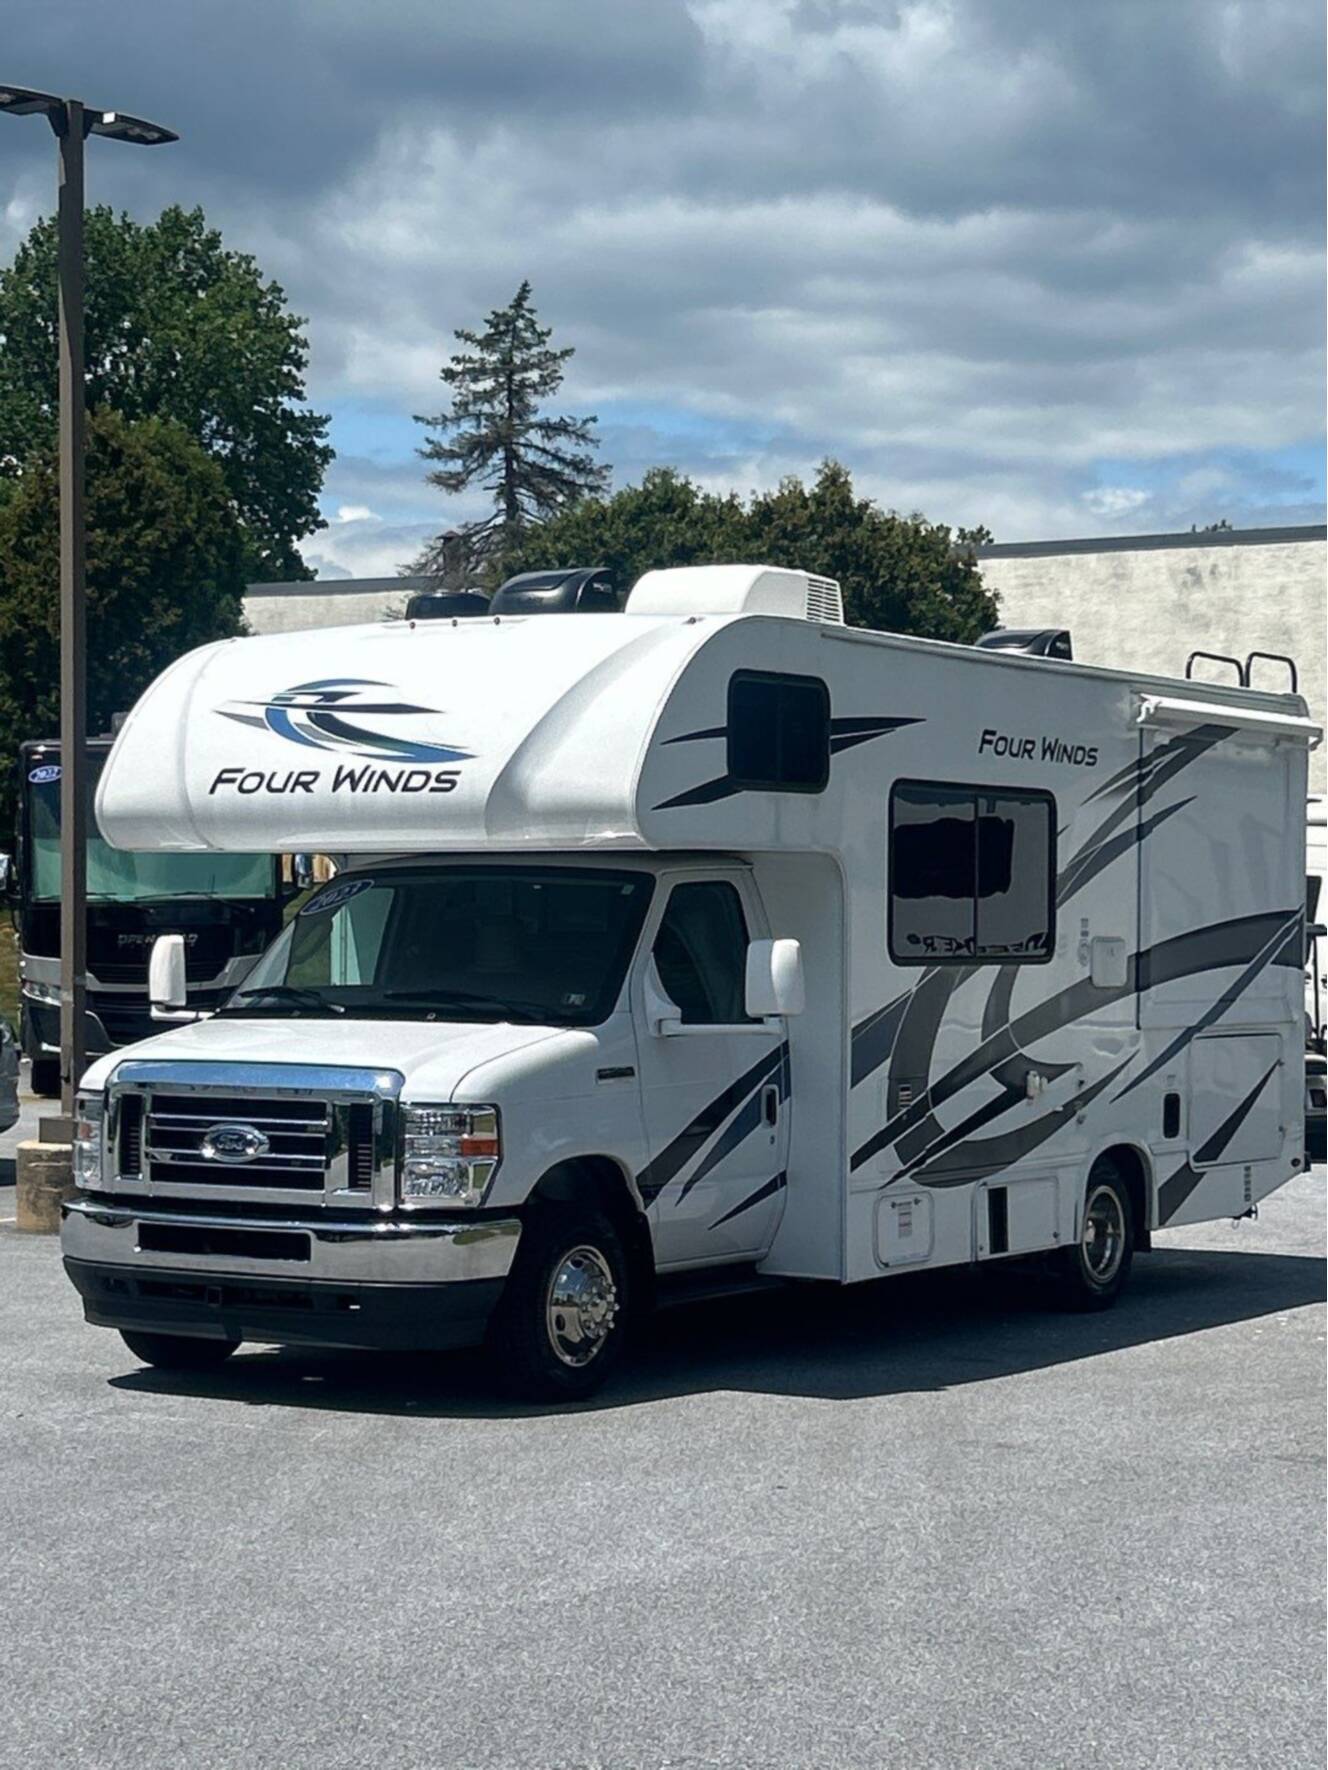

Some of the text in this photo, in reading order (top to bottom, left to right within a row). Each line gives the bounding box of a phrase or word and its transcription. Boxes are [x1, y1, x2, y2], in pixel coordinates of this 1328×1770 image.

[978, 728, 1099, 767] FOUR WINDS
[208, 764, 462, 795] FOUR WINDS
